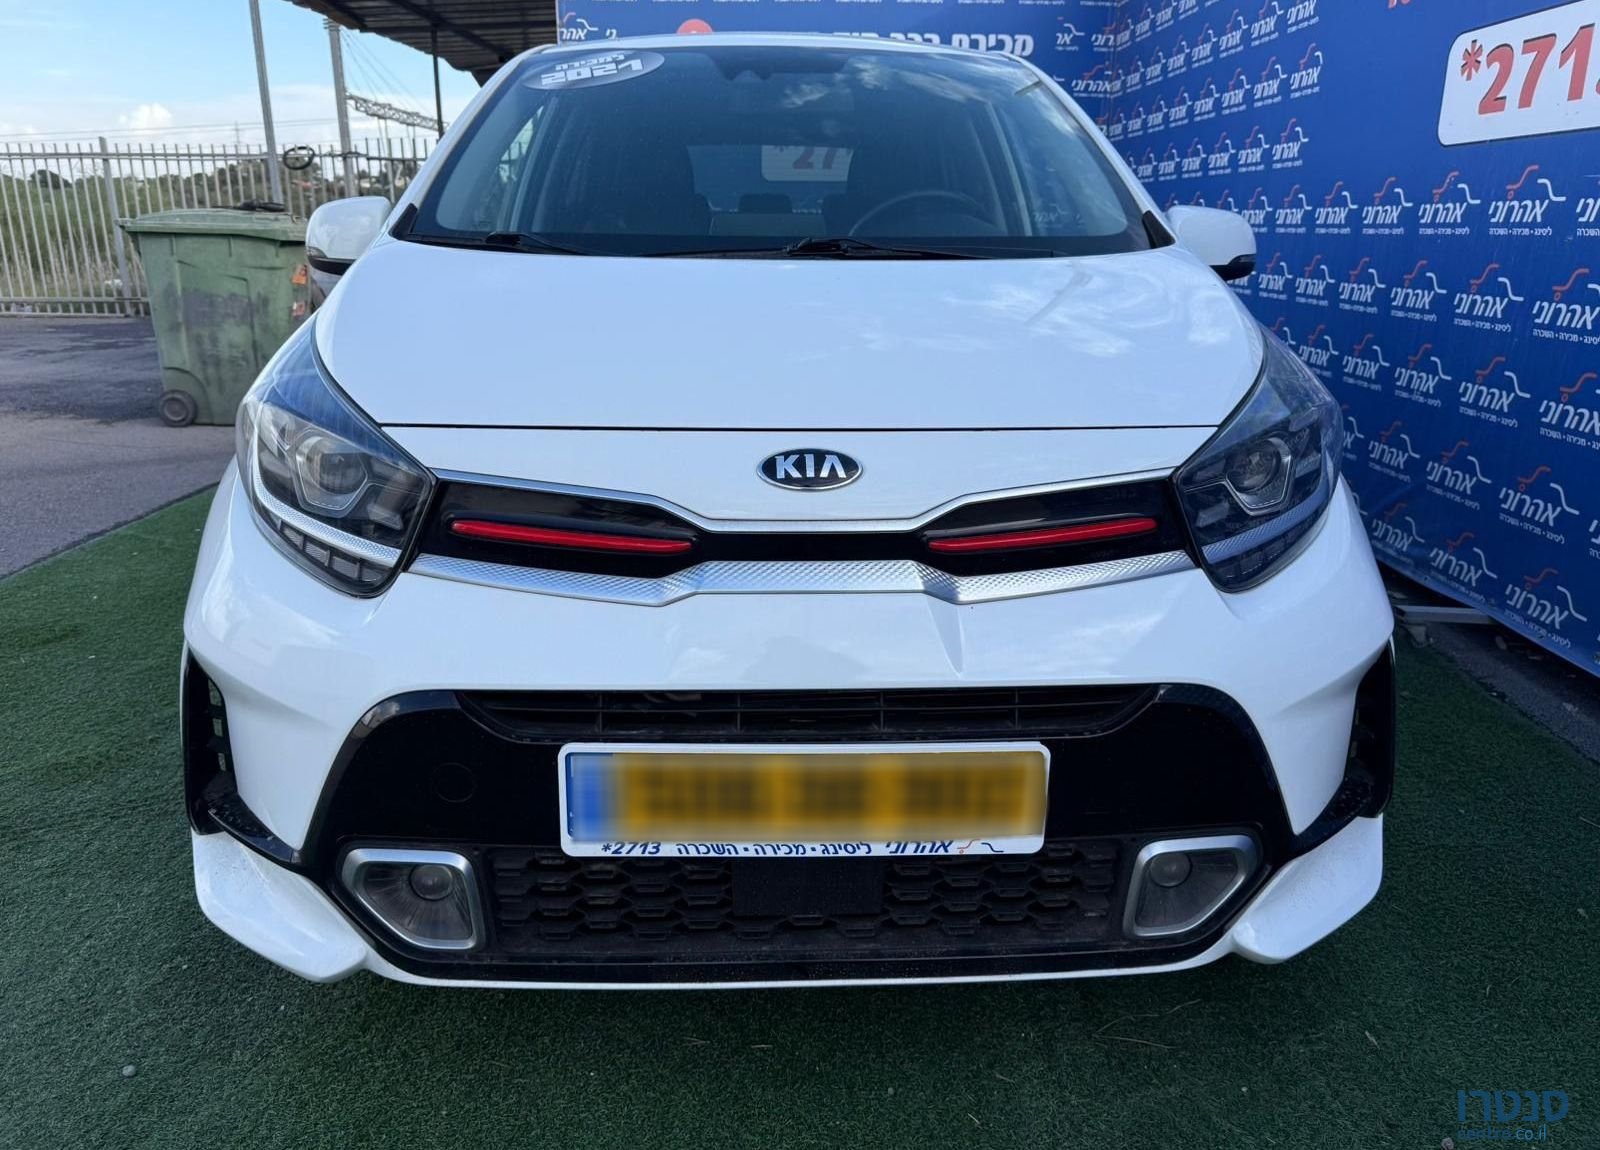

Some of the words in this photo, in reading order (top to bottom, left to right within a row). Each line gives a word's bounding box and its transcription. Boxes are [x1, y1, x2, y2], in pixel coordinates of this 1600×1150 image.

[540, 59, 643, 86] 2021
[1460, 23, 1600, 115] 271
[1362, 205, 1401, 224] אהרוני
[1419, 203, 1466, 223] אהרוני
[1488, 200, 1548, 223] אהרוני
[1390, 287, 1434, 309] אהרוני
[1454, 292, 1508, 318] אהרוני
[1532, 300, 1600, 330] אהרוני
[1394, 367, 1439, 394] אהרוני
[1459, 381, 1515, 412] אהרוני
[775, 453, 847, 479] KIA
[1426, 460, 1477, 494] אהרוני
[1499, 487, 1561, 526] אהרוני
[1430, 548, 1482, 586] אהרוני
[1506, 584, 1569, 629] אהרוני
[675, 843, 738, 856] השכרה
[753, 842, 807, 856] מכירה
[819, 840, 872, 855] ליסינג
